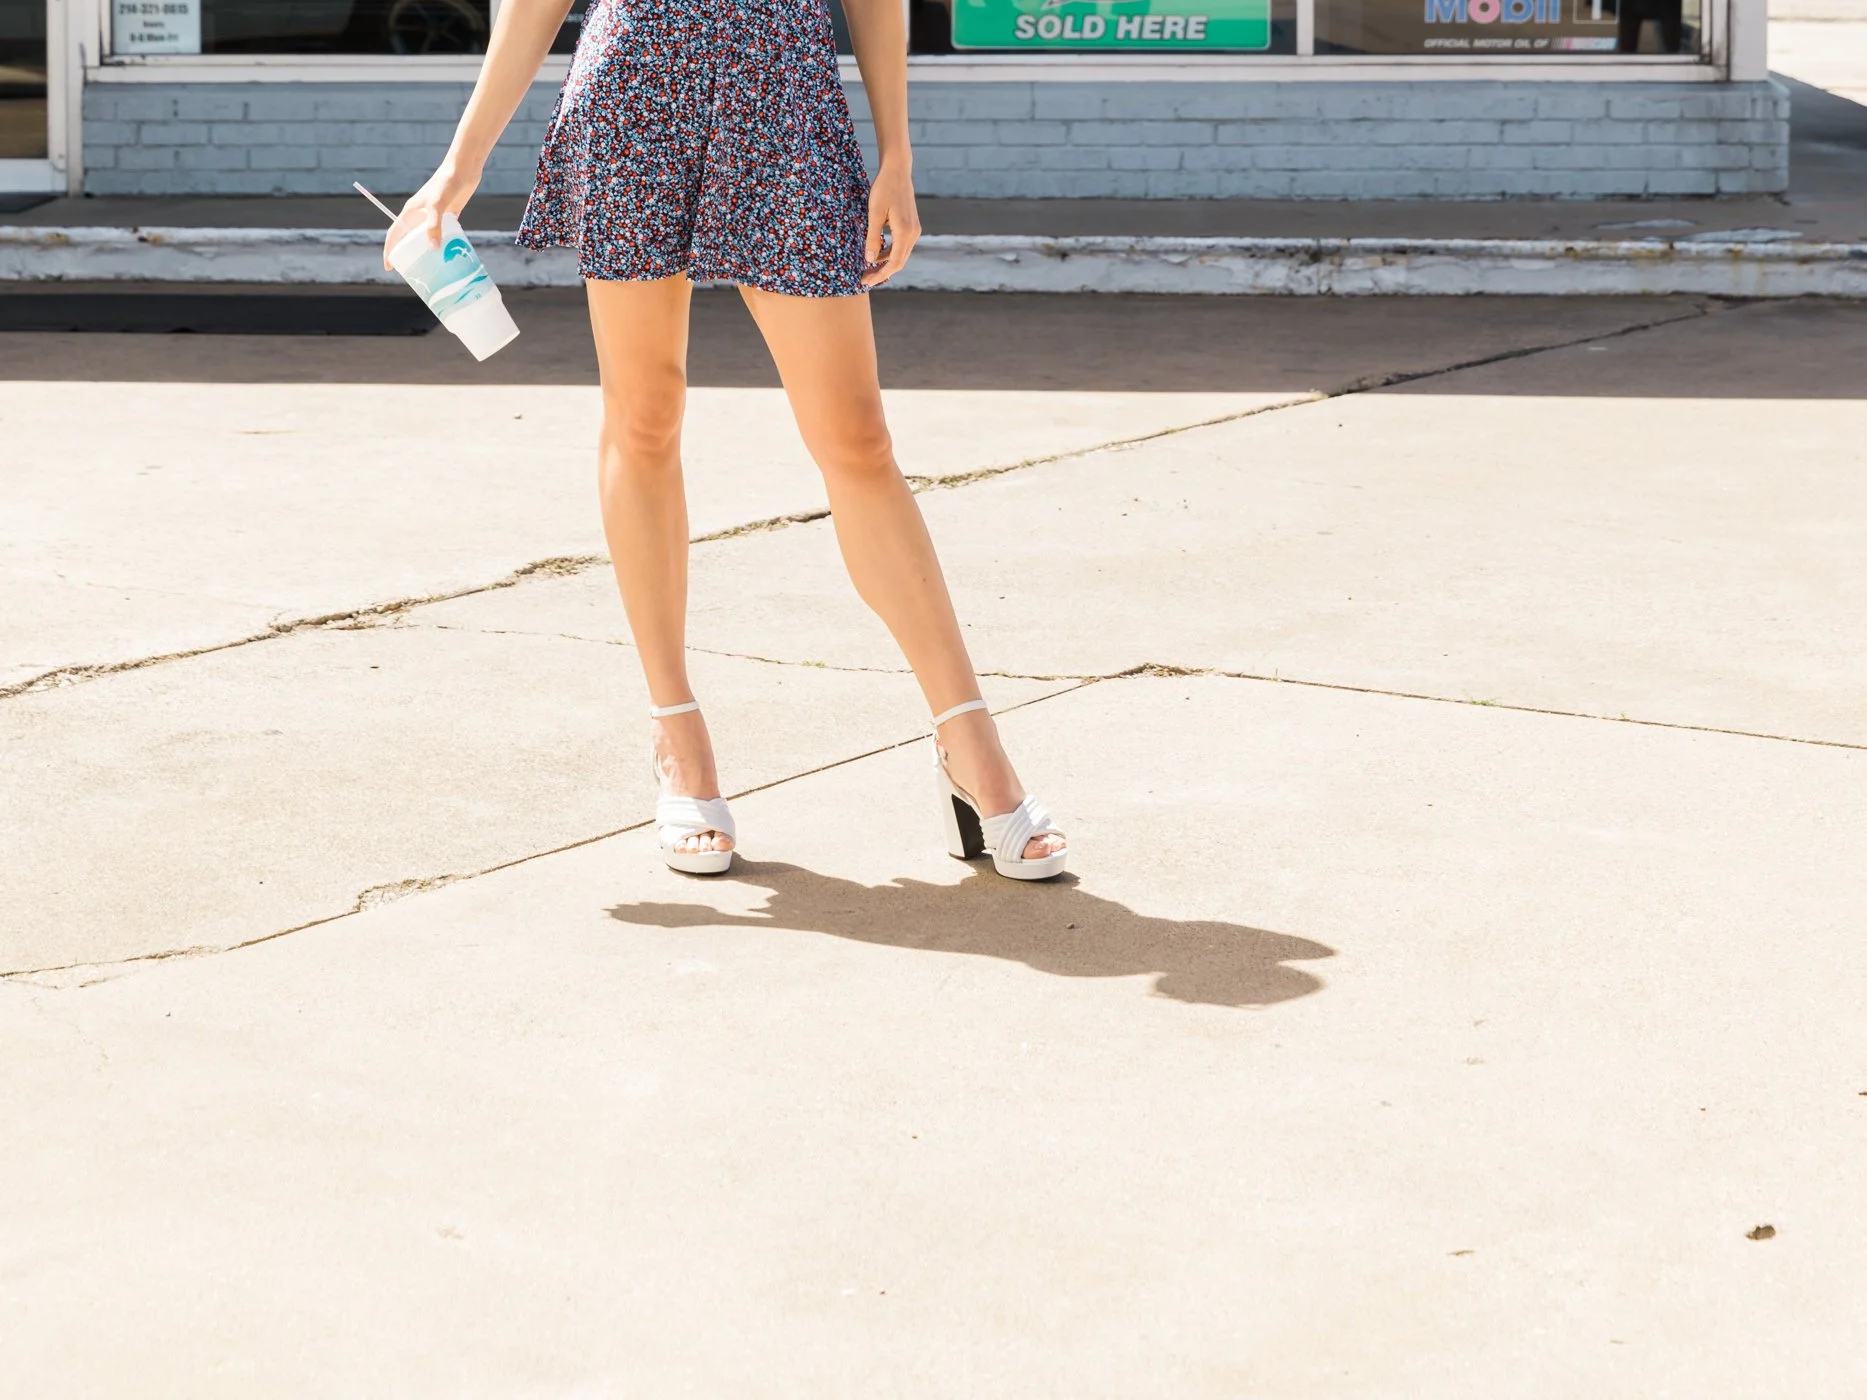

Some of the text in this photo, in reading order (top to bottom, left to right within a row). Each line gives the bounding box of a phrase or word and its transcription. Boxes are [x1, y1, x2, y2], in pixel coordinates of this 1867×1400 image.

[1014, 14, 1209, 41] SOLD HERE
[1423, 37, 1471, 49] OFFICIAL
[1472, 37, 1513, 49] MOTOR
[1514, 38, 1532, 49] OIL
[1533, 38, 1550, 49] OF
